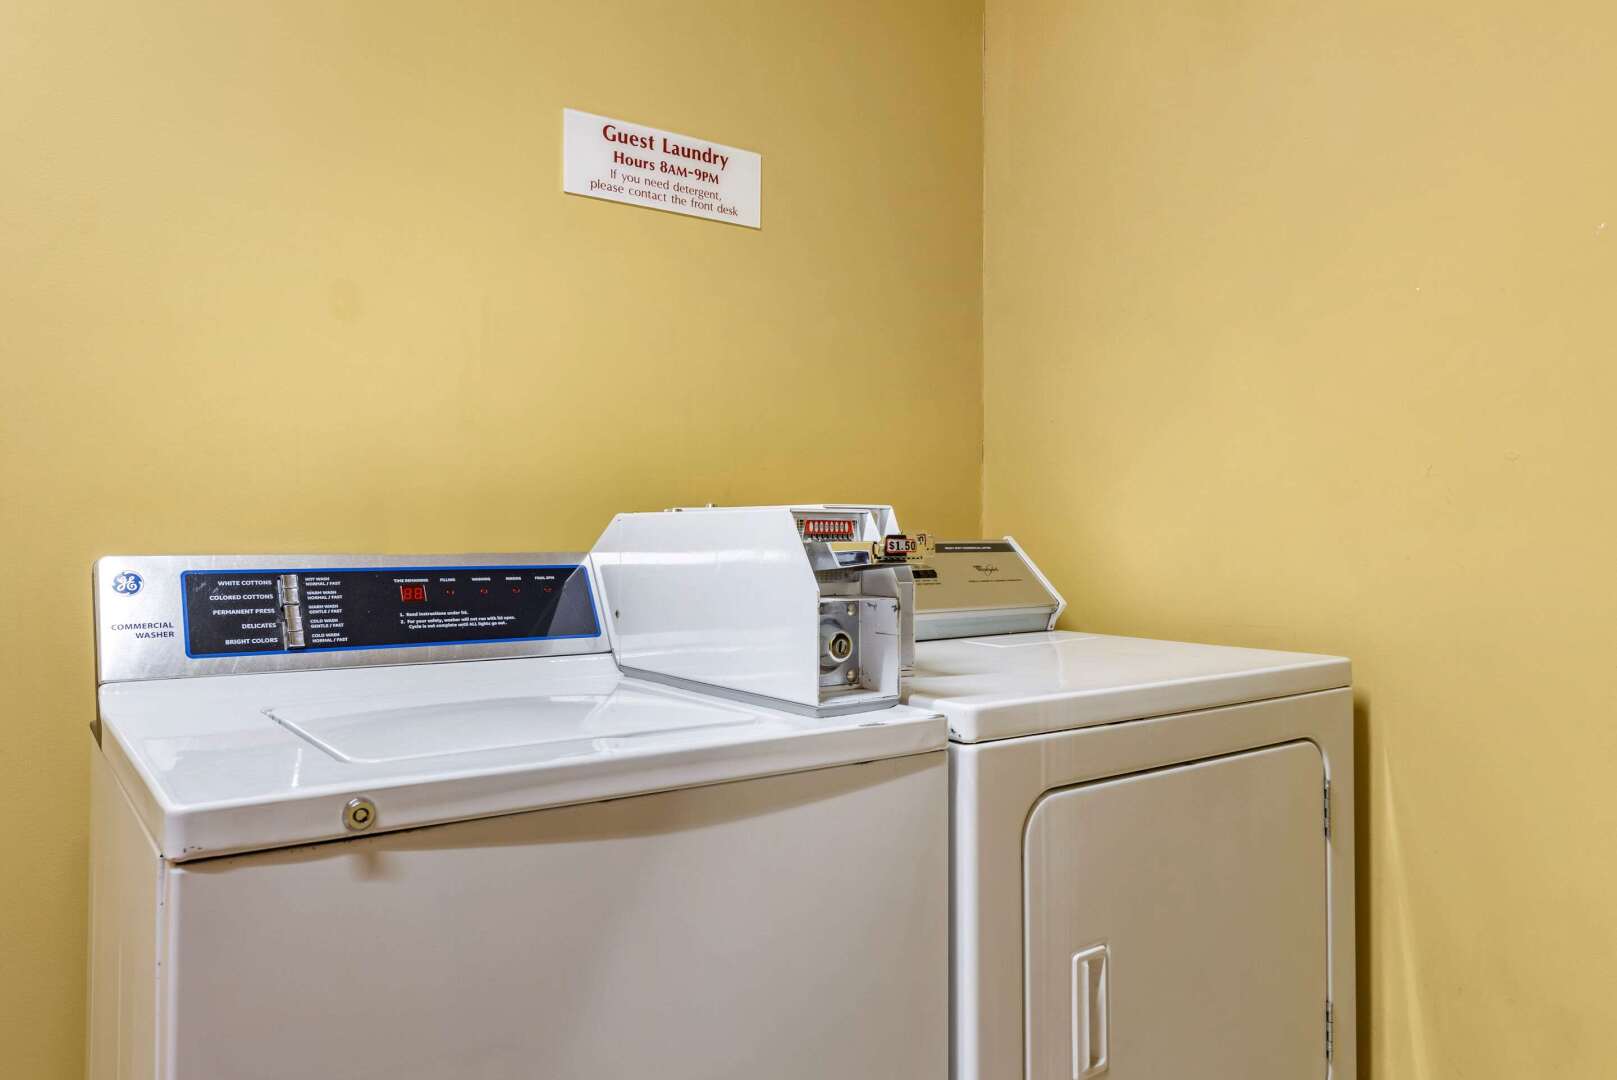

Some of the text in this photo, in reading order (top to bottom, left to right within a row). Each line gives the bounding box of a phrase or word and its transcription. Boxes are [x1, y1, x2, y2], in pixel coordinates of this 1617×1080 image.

[602, 124, 729, 170] Guest Laundry
[613, 151, 719, 185] Hours 8AM-9PM
[590, 178, 738, 216] please contact the front desk
[610, 169, 722, 201] If you need detergent,
[889, 540, 917, 551] $1.50
[111, 622, 175, 631] COMMERCIAL
[135, 631, 175, 639] WASHER
